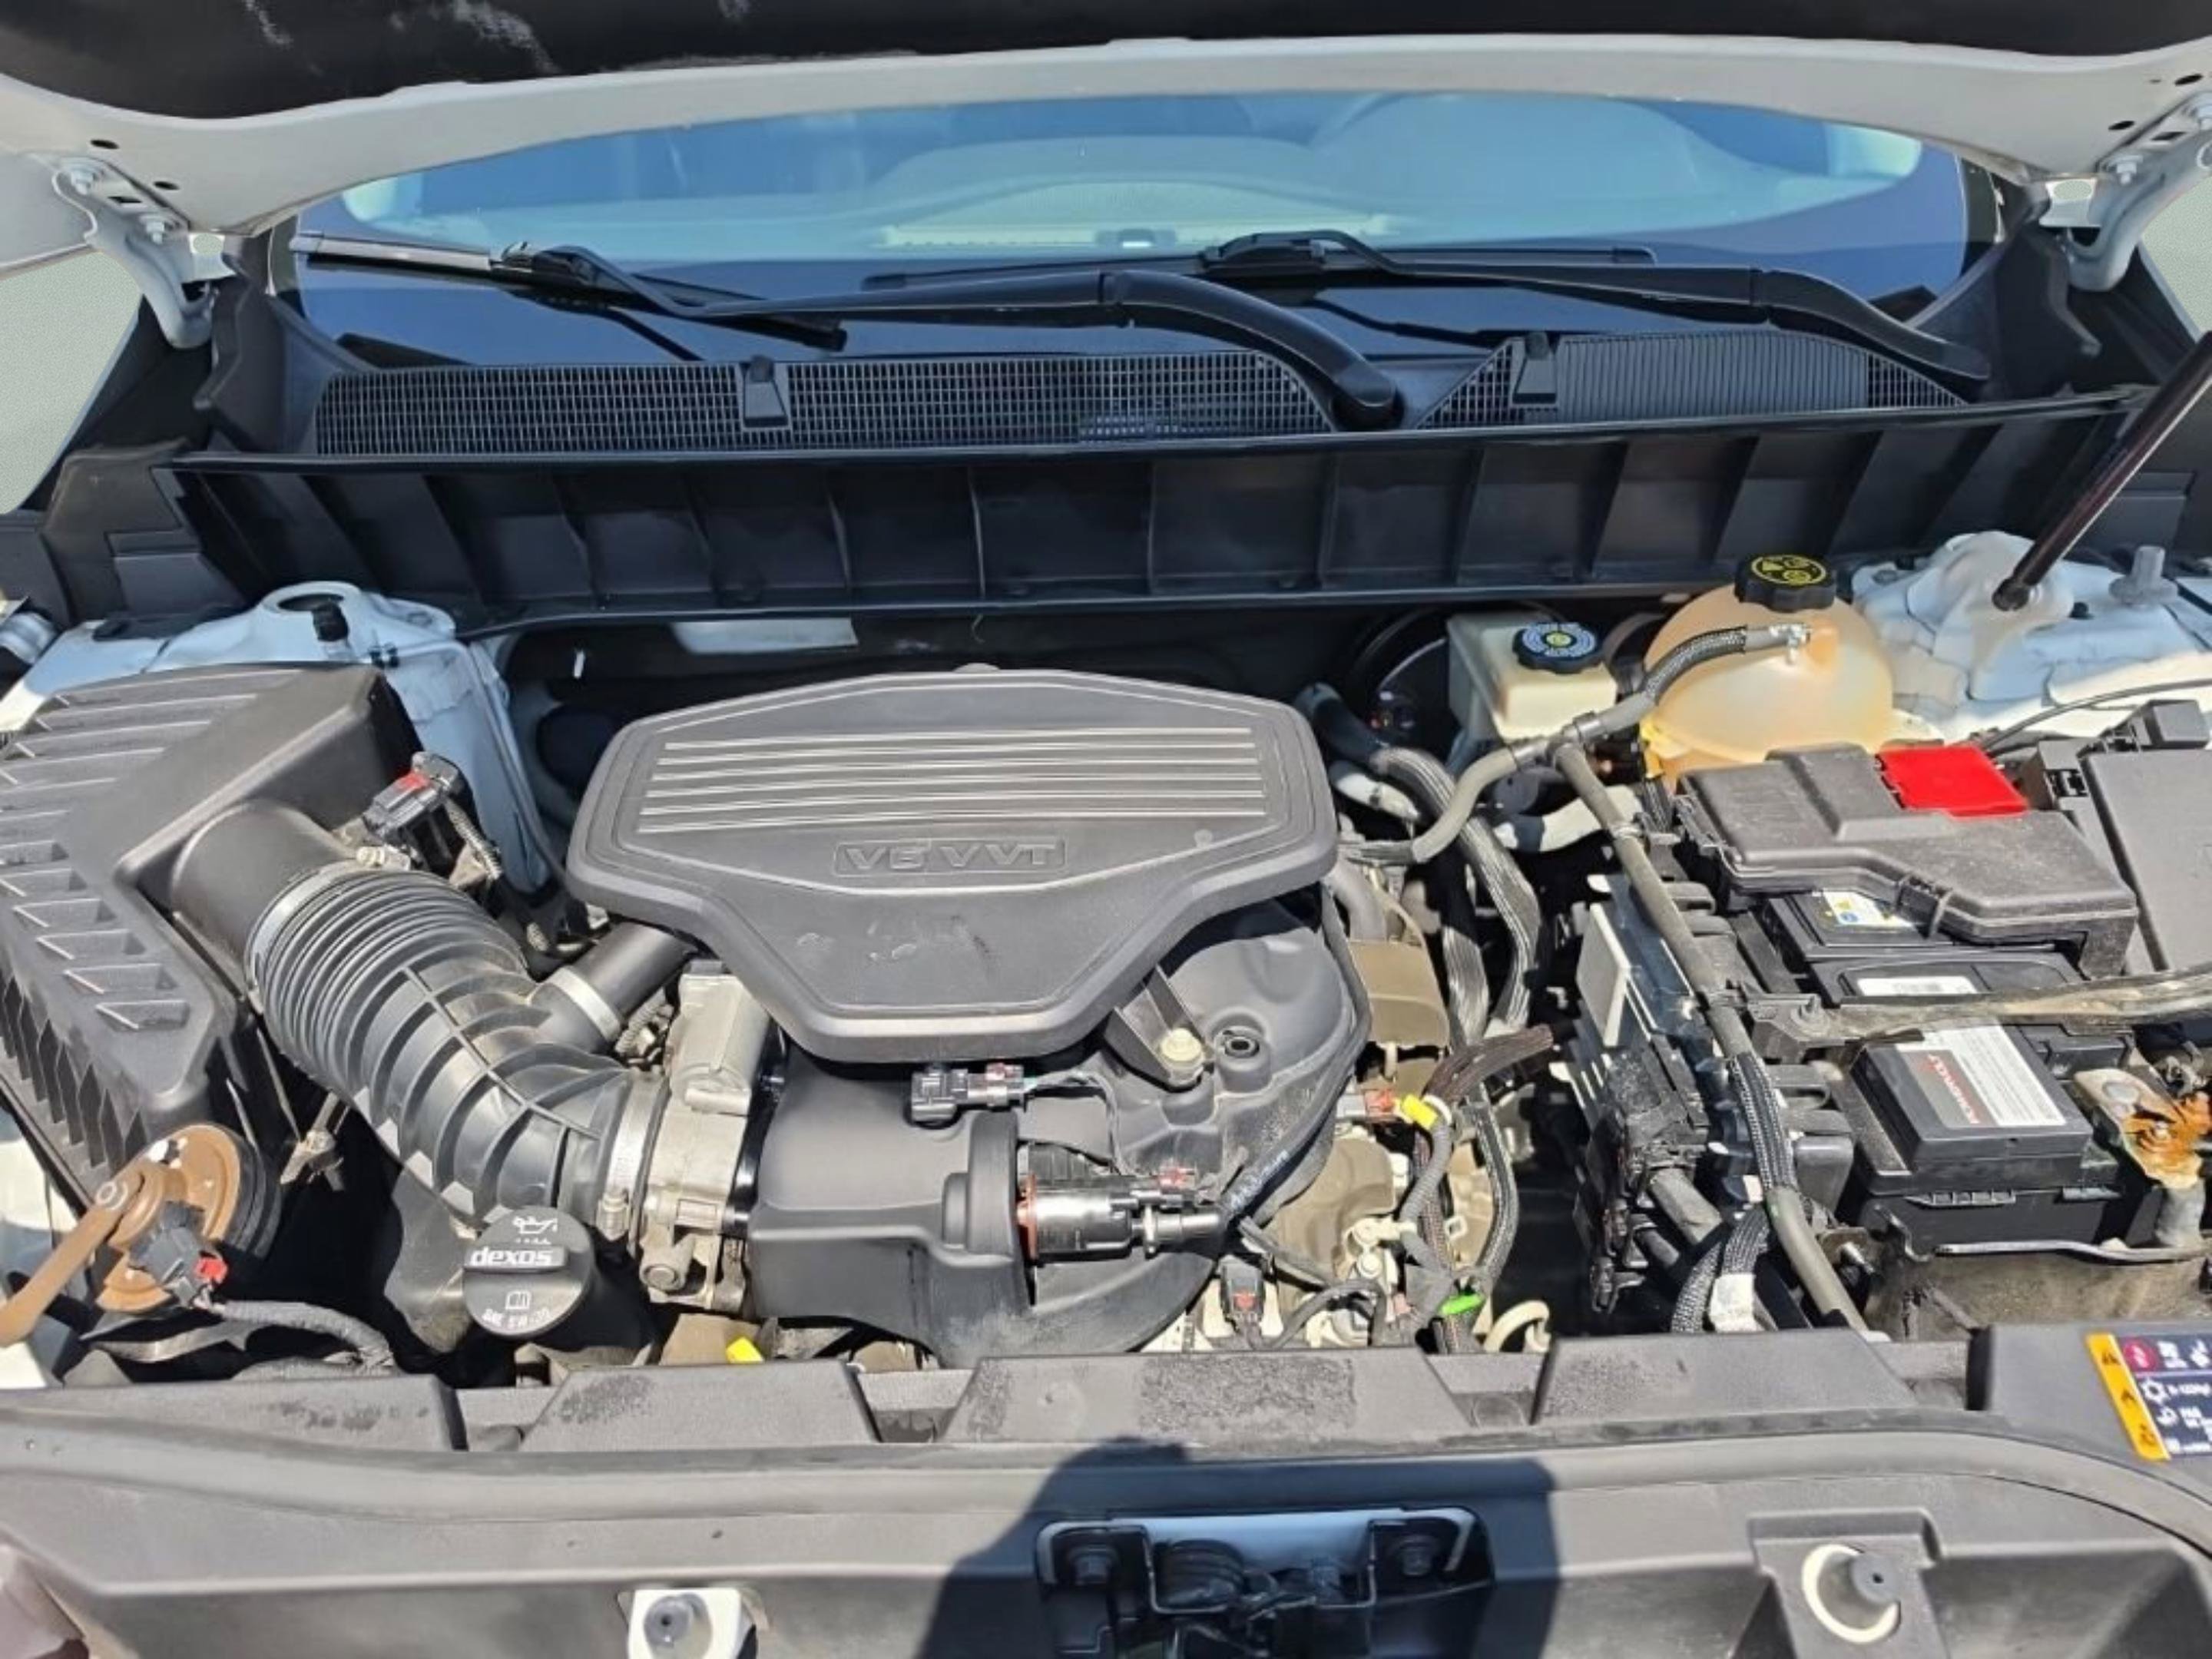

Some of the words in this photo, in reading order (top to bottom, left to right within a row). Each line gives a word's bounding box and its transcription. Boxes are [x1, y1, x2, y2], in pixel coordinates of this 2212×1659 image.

[846, 846, 925, 869] V6
[939, 843, 1056, 866] VVT
[470, 1246, 554, 1266] dexos
